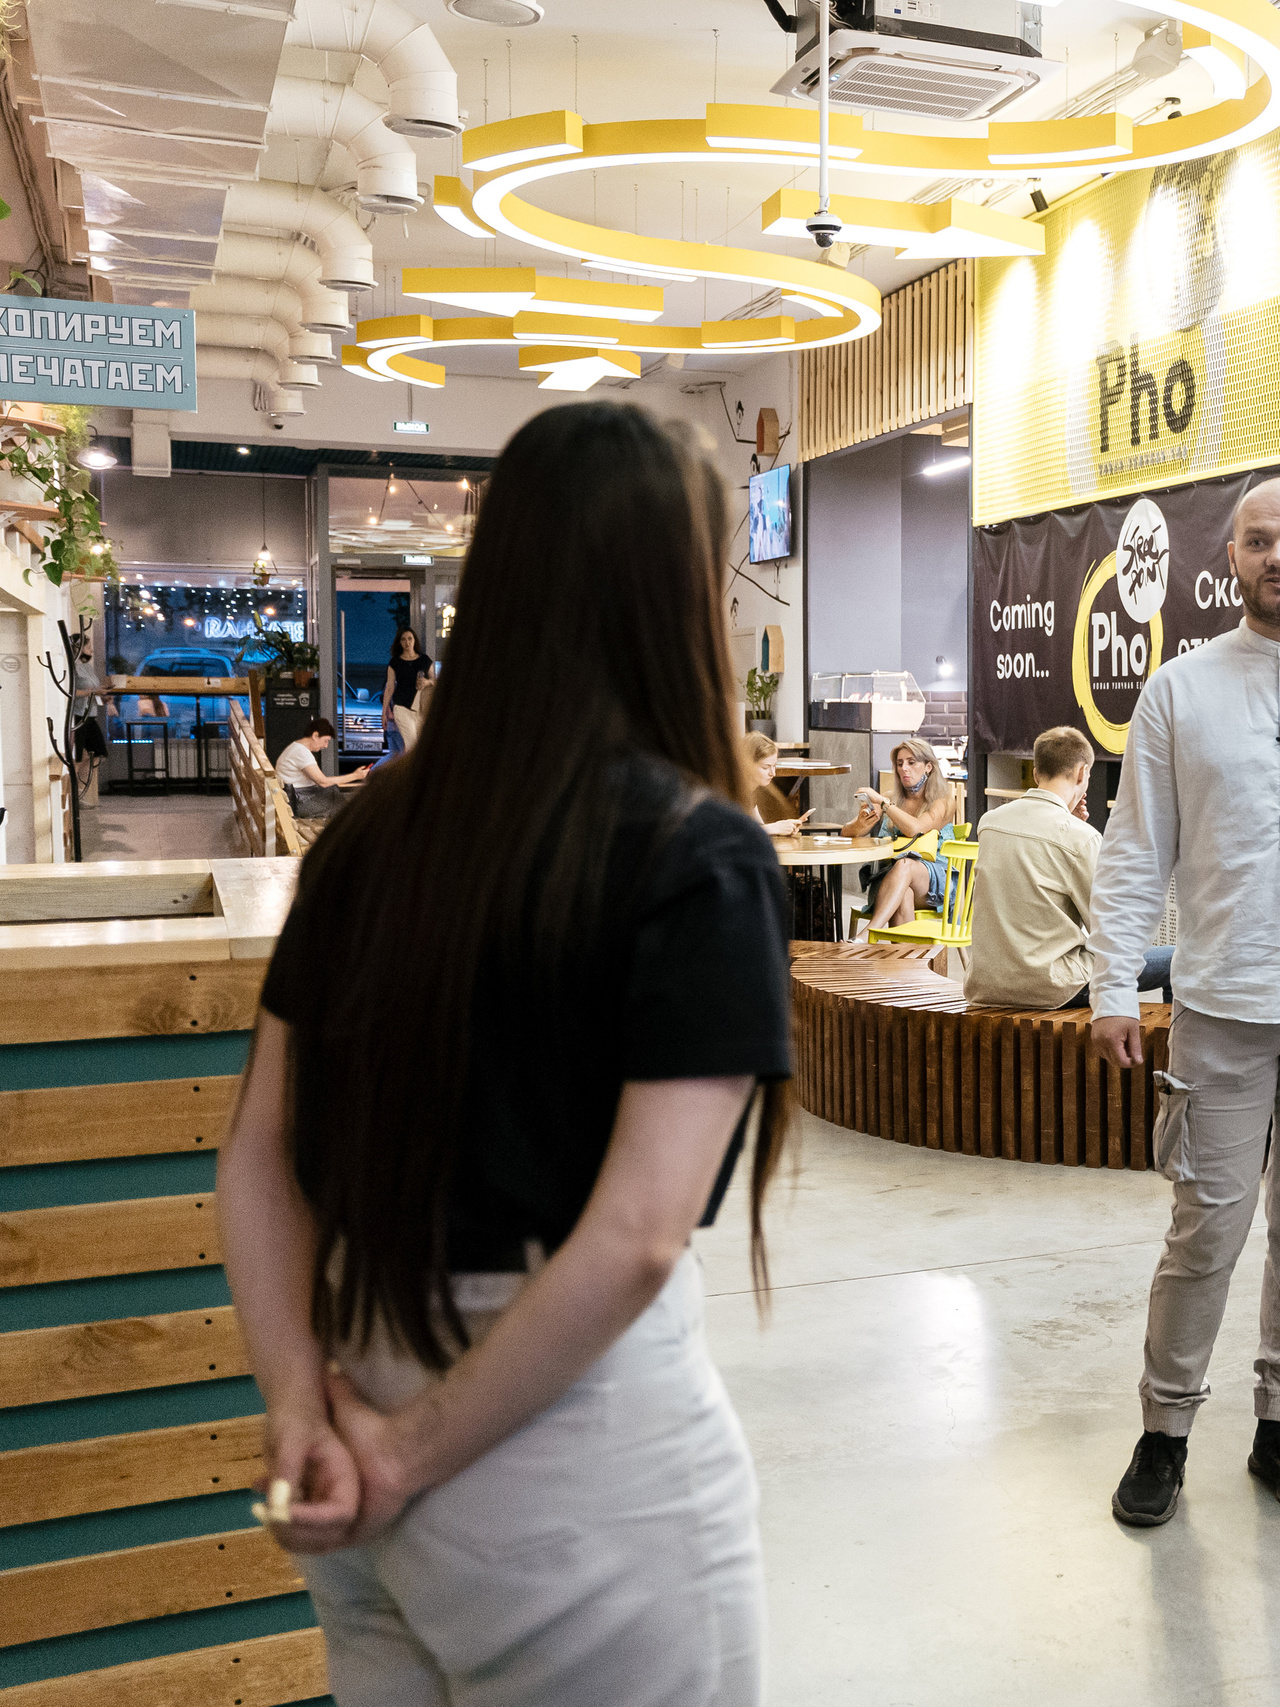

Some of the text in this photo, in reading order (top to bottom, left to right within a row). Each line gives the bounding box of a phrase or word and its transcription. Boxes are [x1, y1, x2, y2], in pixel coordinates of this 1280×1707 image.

[1096, 332, 1196, 454] Pho
[989, 593, 1055, 637] Coming
[996, 652, 1050, 680] soon...
[1091, 611, 1147, 678] Pho
